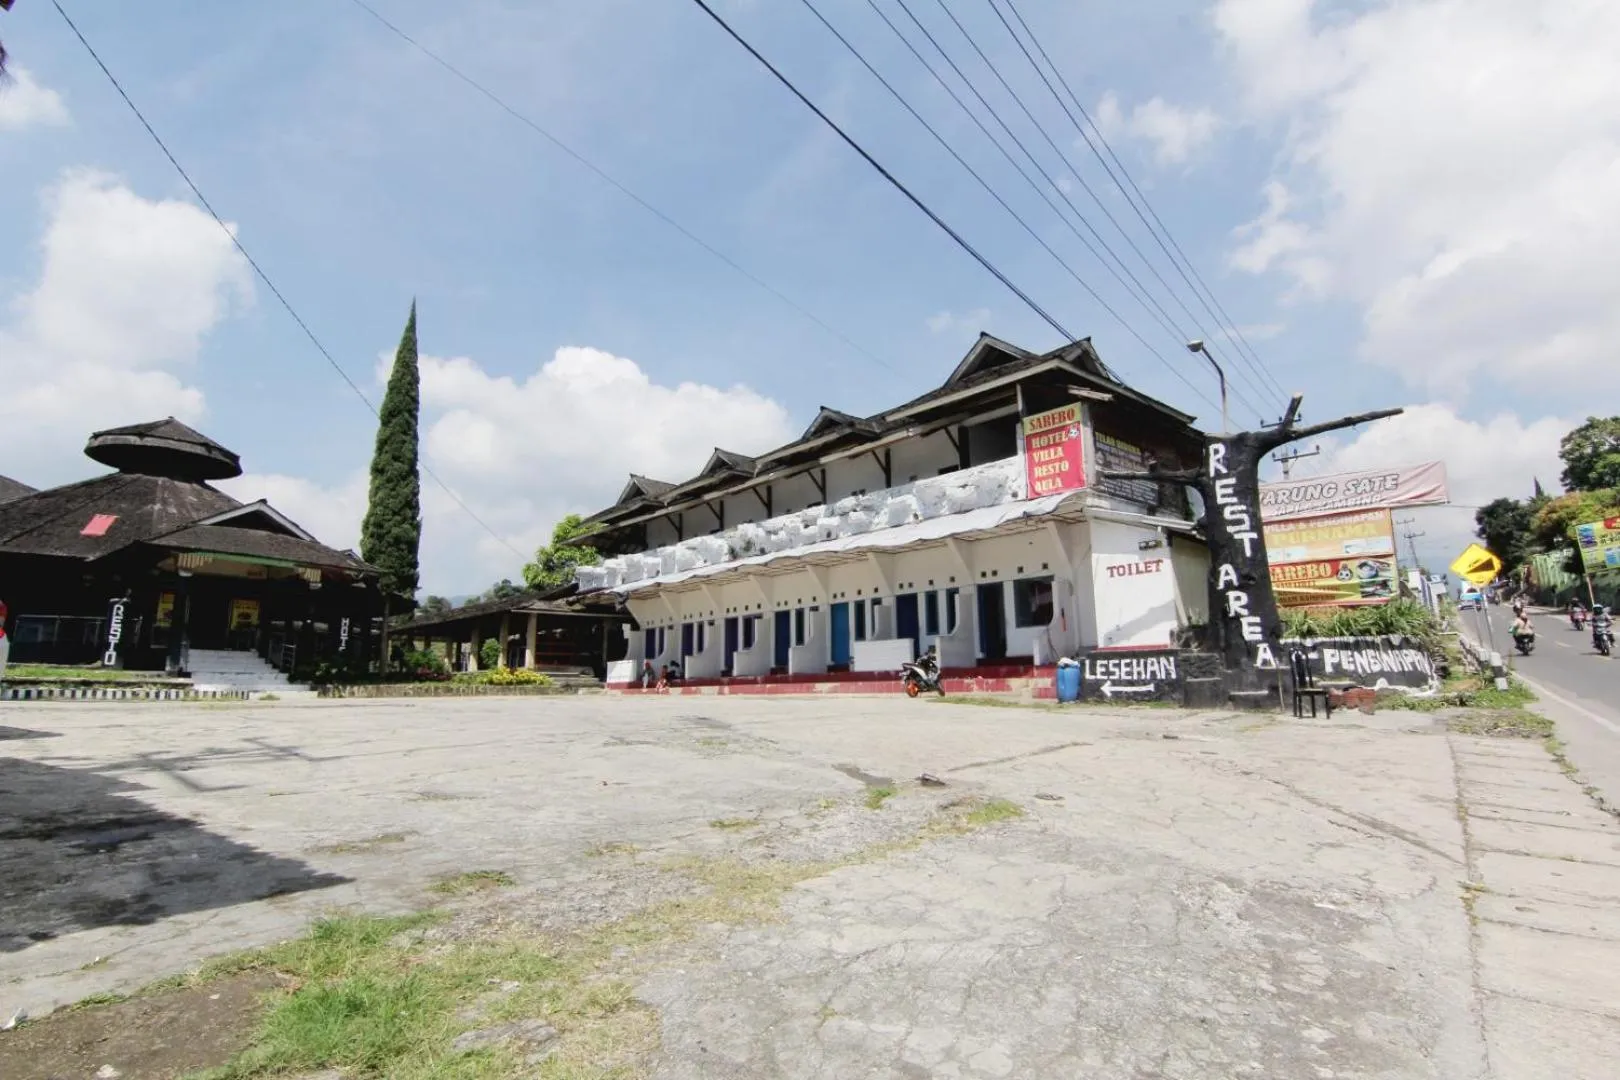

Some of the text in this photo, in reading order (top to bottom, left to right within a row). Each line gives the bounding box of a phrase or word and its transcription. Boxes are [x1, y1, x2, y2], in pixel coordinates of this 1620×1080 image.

[1030, 408, 1075, 430] SAREBO
[1032, 430, 1069, 448] HOTEL
[1033, 446, 1065, 463] VILLA
[1034, 460, 1069, 479] RESTO
[1345, 473, 1400, 496] SATE
[1209, 443, 1276, 669] REST AREA
[1106, 559, 1164, 578] TOILET
[104, 604, 124, 666] RESTO
[1085, 656, 1177, 680] LESEHAN
